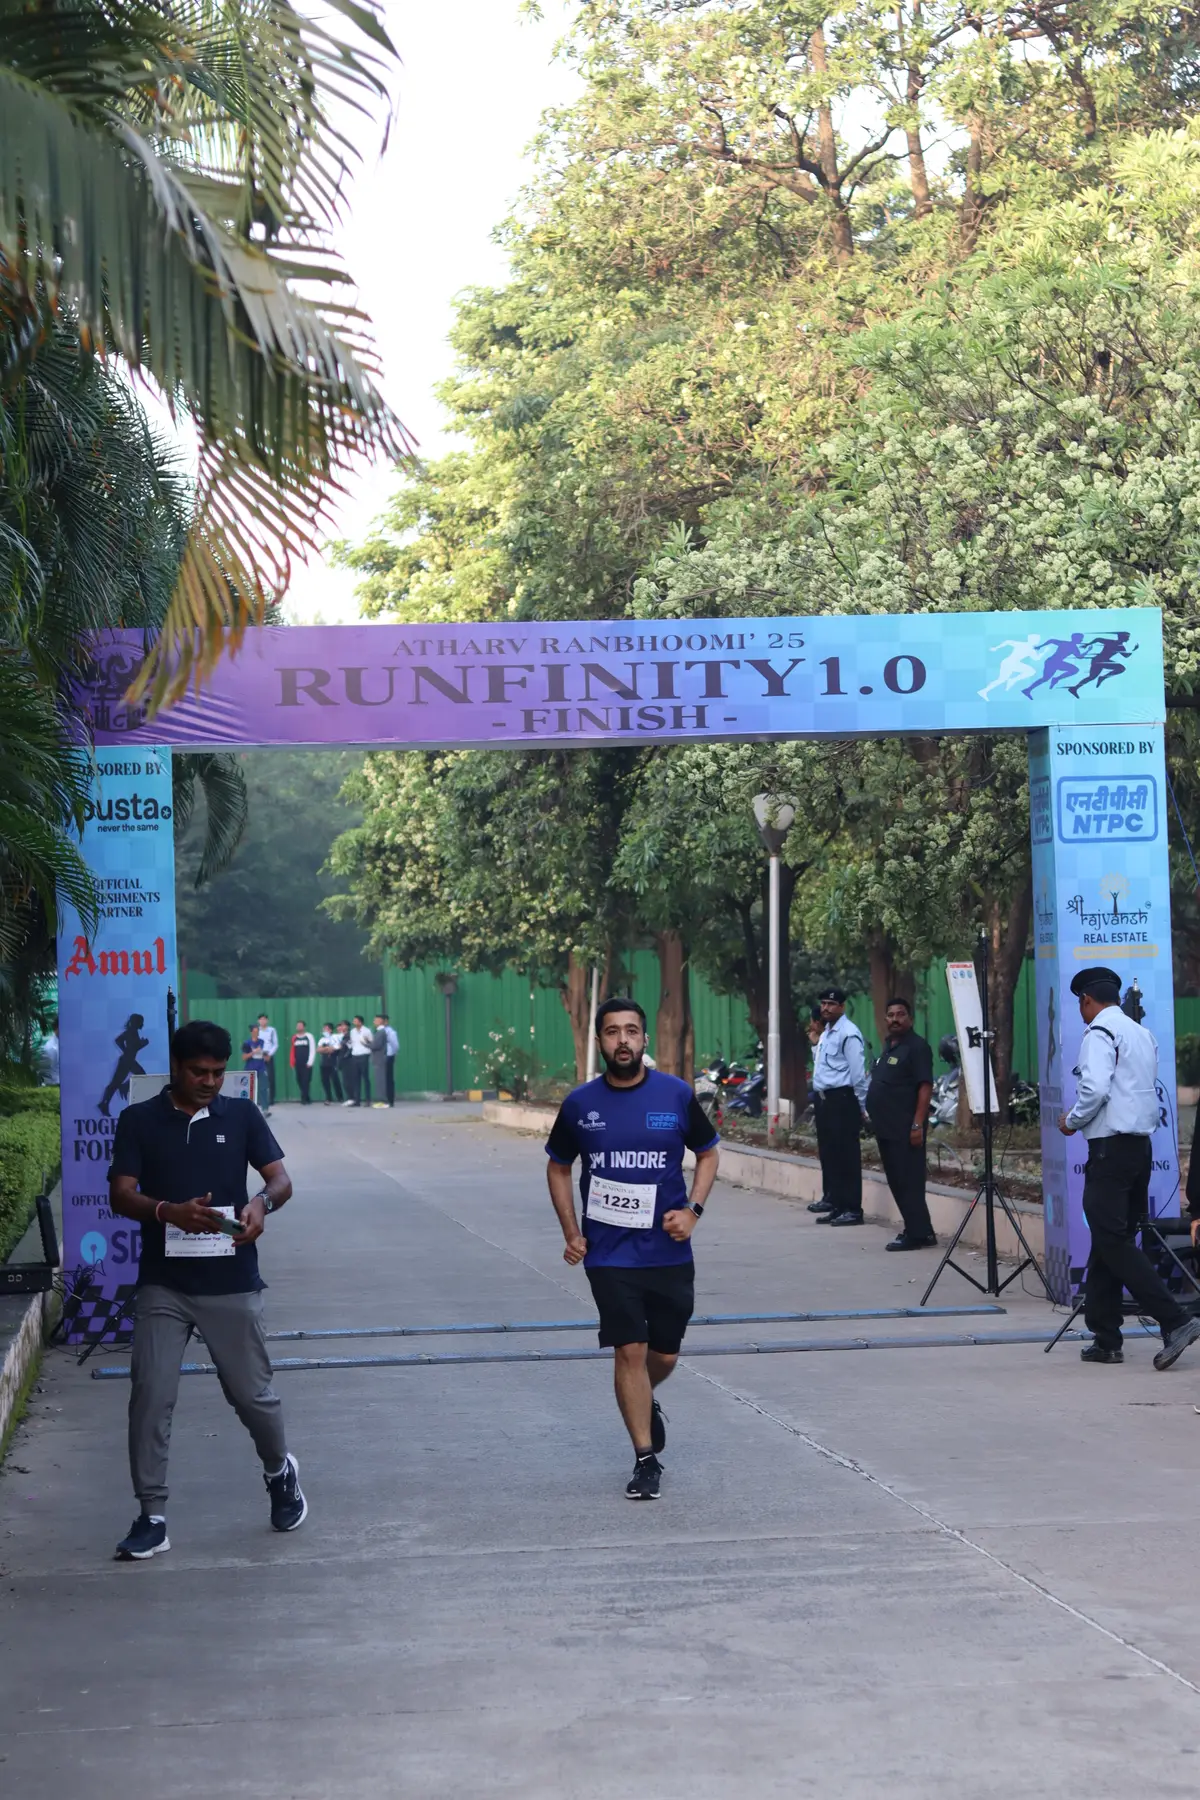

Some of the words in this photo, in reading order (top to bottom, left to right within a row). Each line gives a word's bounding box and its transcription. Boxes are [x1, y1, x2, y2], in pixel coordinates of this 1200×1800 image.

[393, 637, 528, 656] ATHARV
[768, 632, 805, 649] 25
[520, 705, 709, 733] FINISH
[1057, 741, 1135, 756] SPONSORED
[1139, 740, 1155, 754] BY
[145, 761, 161, 775] BY
[1066, 785, 1148, 812] एनटीपीसी
[98, 824, 120, 832] never
[122, 824, 135, 832] the
[1073, 813, 1144, 834] NTPC
[99, 907, 143, 917] ARTNER
[1080, 909, 1148, 930] rajvansh
[1083, 933, 1109, 944] REAL
[1112, 932, 1148, 943] ESTATE
[65, 936, 167, 981] Amul
[610, 1151, 667, 1169] INDORE
[72, 1194, 110, 1207] OFFICI
[602, 1193, 640, 1210] 1223
